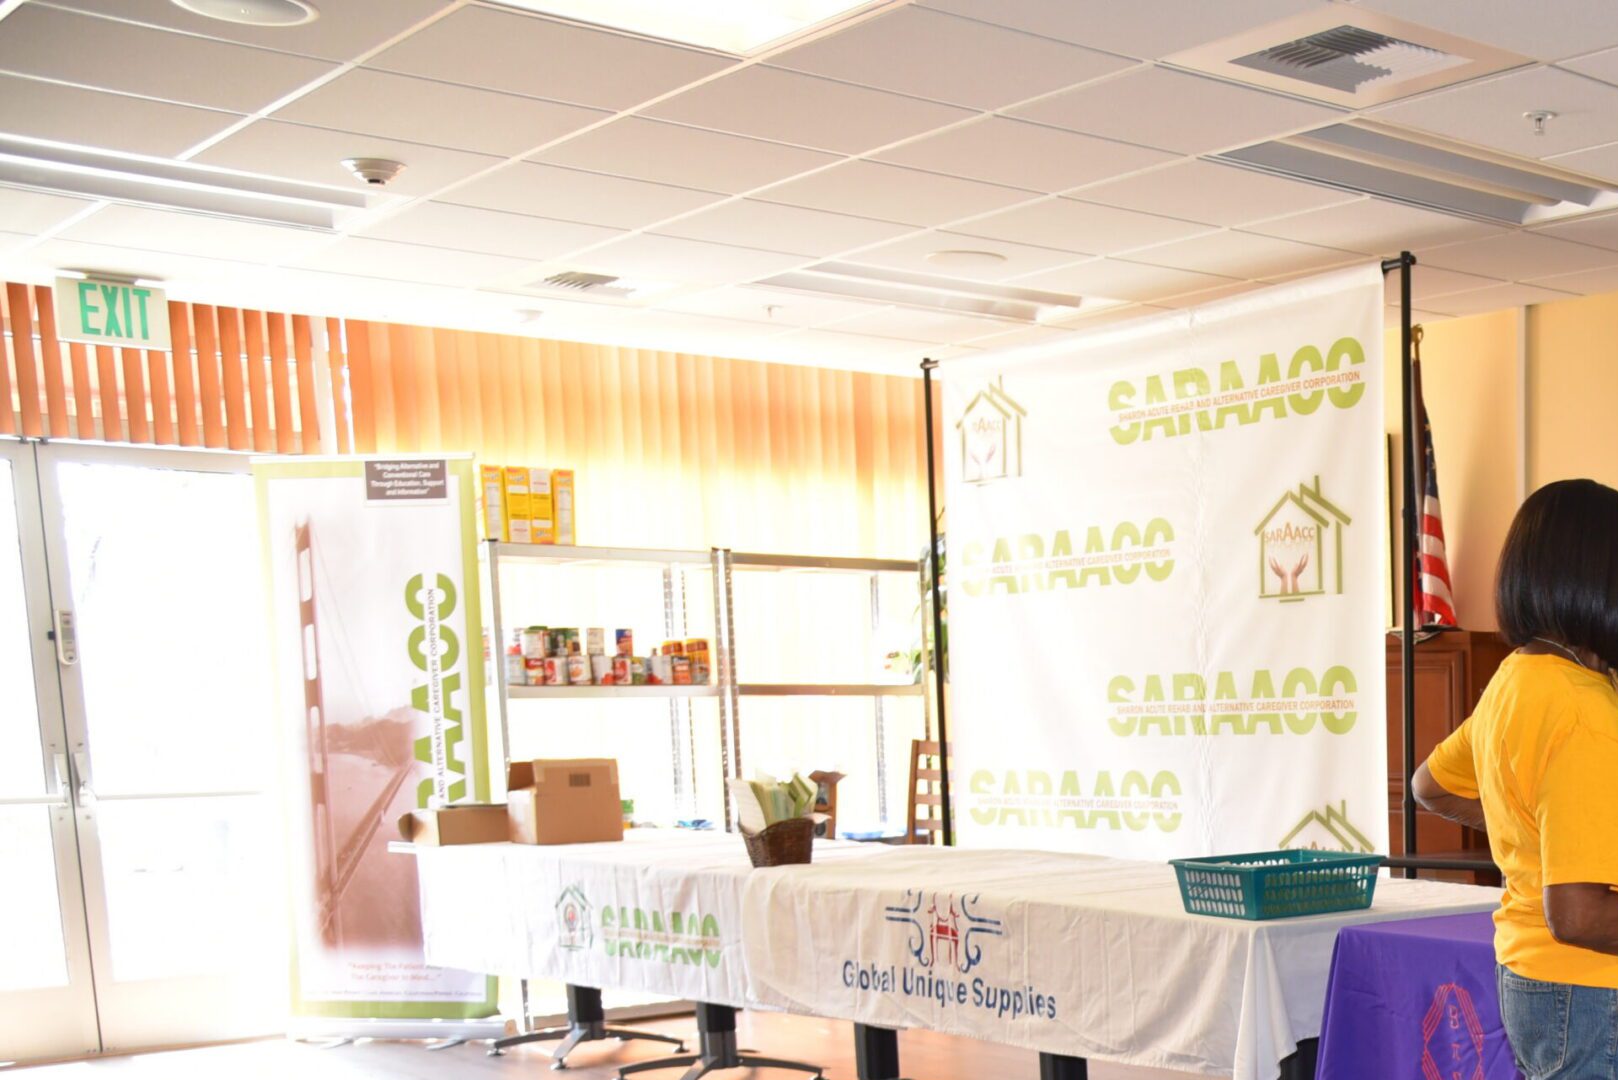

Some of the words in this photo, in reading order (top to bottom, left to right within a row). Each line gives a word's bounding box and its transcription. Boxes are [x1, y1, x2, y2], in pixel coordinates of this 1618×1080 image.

[78, 282, 151, 340] EXIT
[1108, 336, 1366, 446] SARAACC
[1213, 389, 1259, 407] ALTERNATIVE
[1261, 381, 1302, 399] CAREGIVER
[1303, 370, 1361, 390] CORPORATION
[427, 588, 438, 656] CORPORATION
[430, 659, 440, 713] CAREGIVER
[1107, 665, 1358, 737] SARAACC
[1209, 702, 1255, 713] ALTERNATIVE
[1256, 700, 1298, 712] CAREGIVER
[1300, 699, 1354, 710] CORPORATION
[434, 717, 445, 778] ALTERNATIVE
[969, 769, 1183, 833] SARAACC
[842, 960, 896, 993] Global
[903, 966, 967, 1008] Unique
[972, 978, 1057, 1020] Supplies
